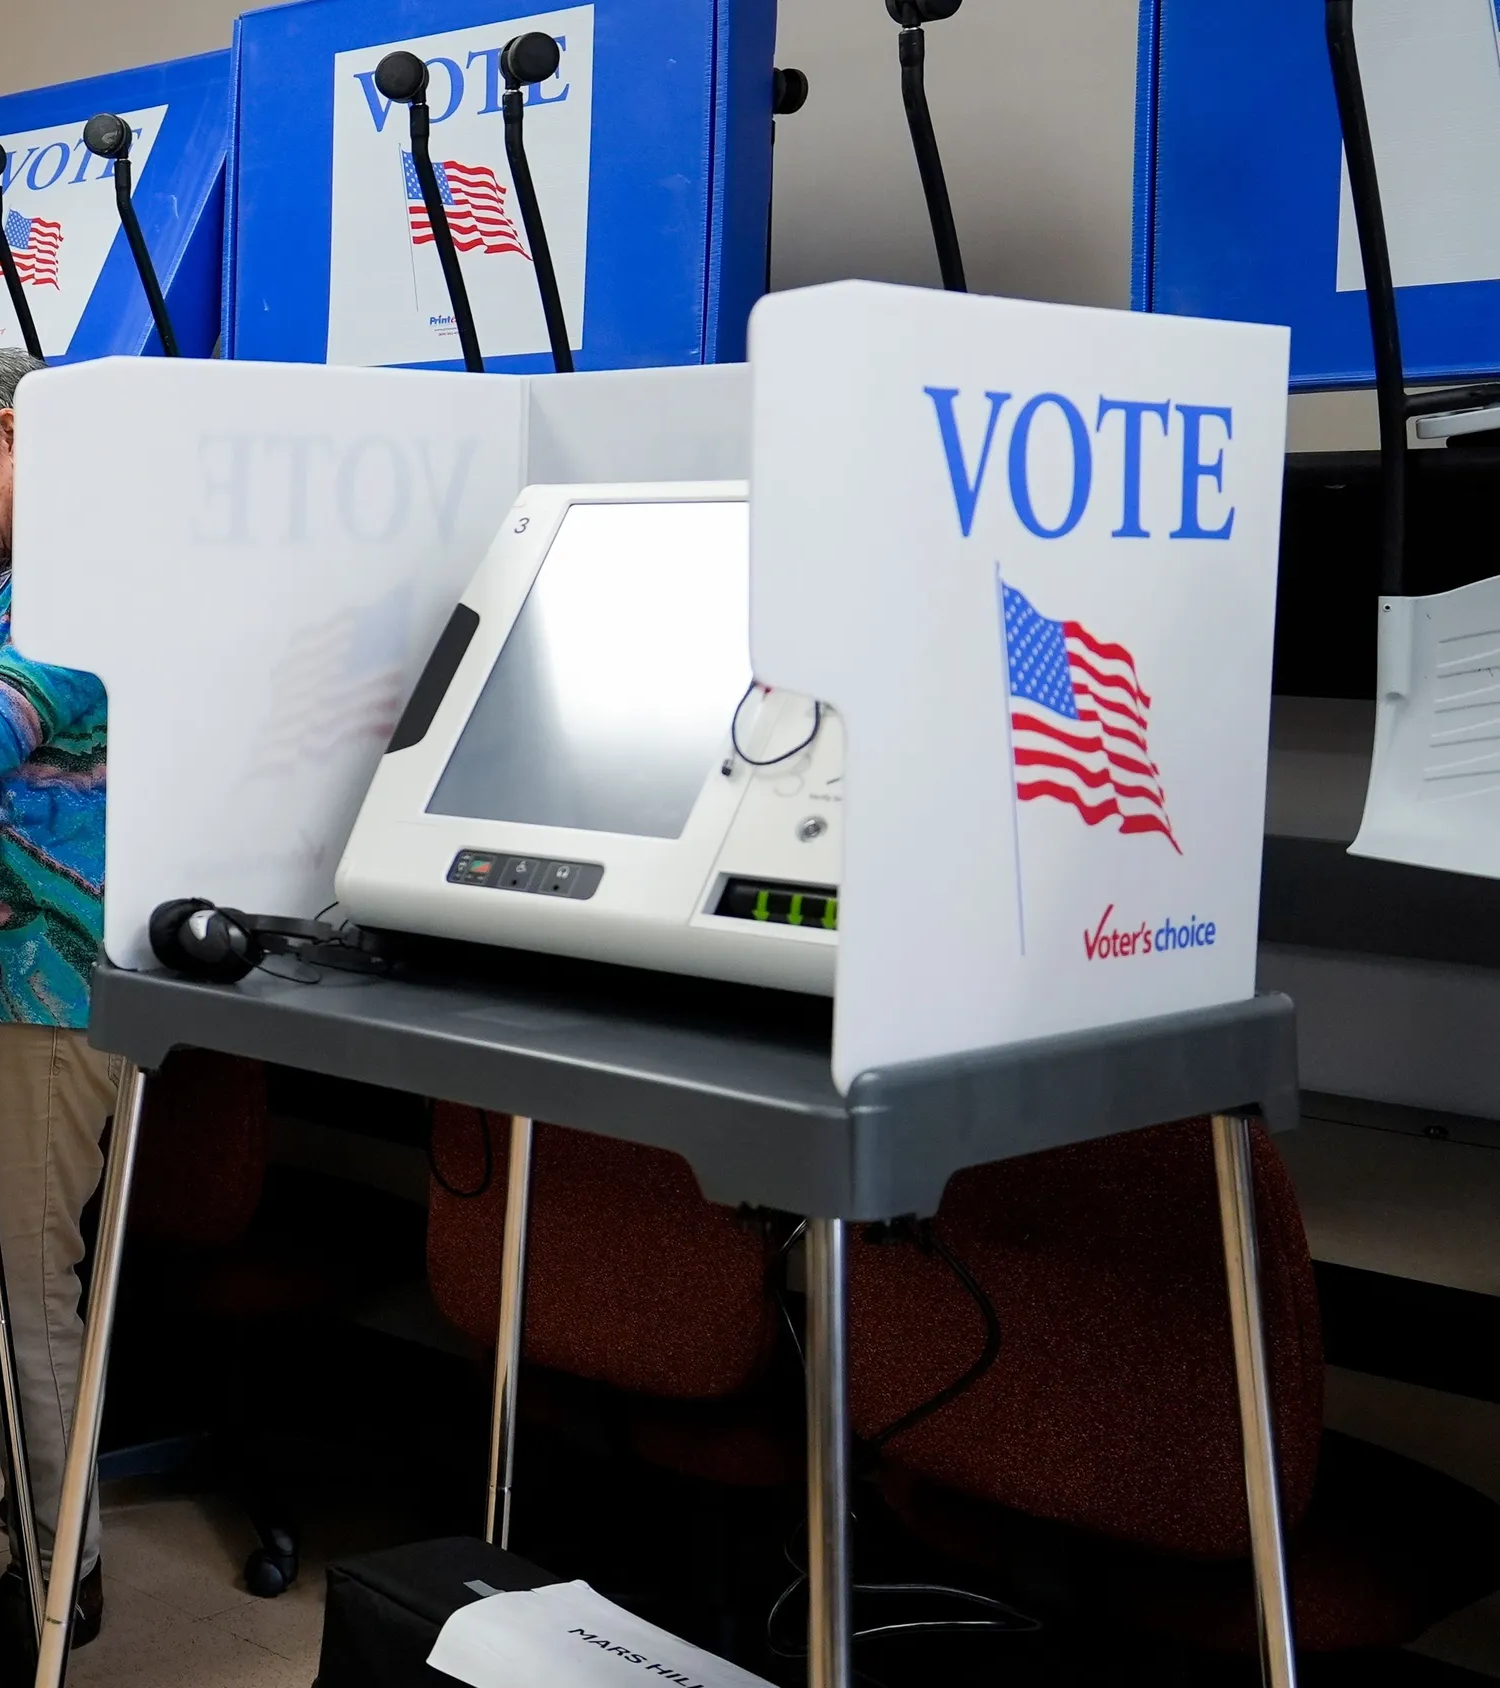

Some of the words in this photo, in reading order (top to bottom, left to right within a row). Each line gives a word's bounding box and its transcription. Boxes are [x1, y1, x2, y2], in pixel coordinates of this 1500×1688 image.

[923, 385, 1235, 540] VOTE
[514, 517, 530, 534] 3
[1084, 904, 1152, 961] Voter's
[1155, 914, 1216, 952] choice
[567, 1628, 648, 1664] MARS
